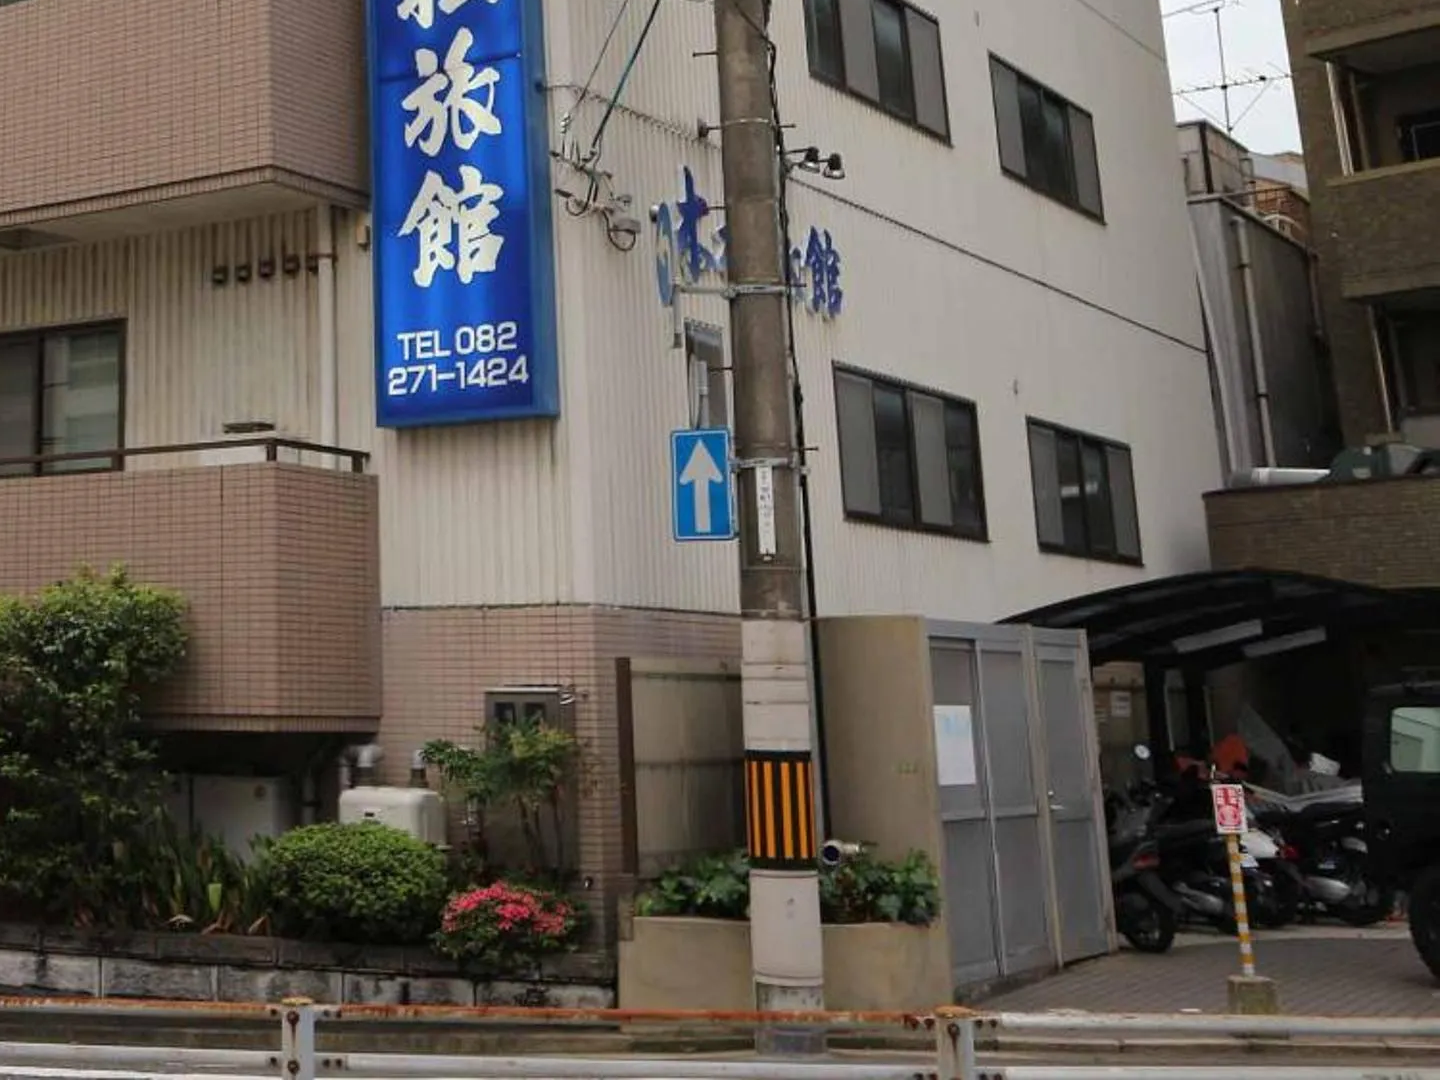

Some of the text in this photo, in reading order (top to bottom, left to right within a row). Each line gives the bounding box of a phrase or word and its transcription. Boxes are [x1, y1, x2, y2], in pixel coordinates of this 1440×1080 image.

[397, 320, 518, 361] TEL 082
[387, 354, 529, 396] 271-1424
